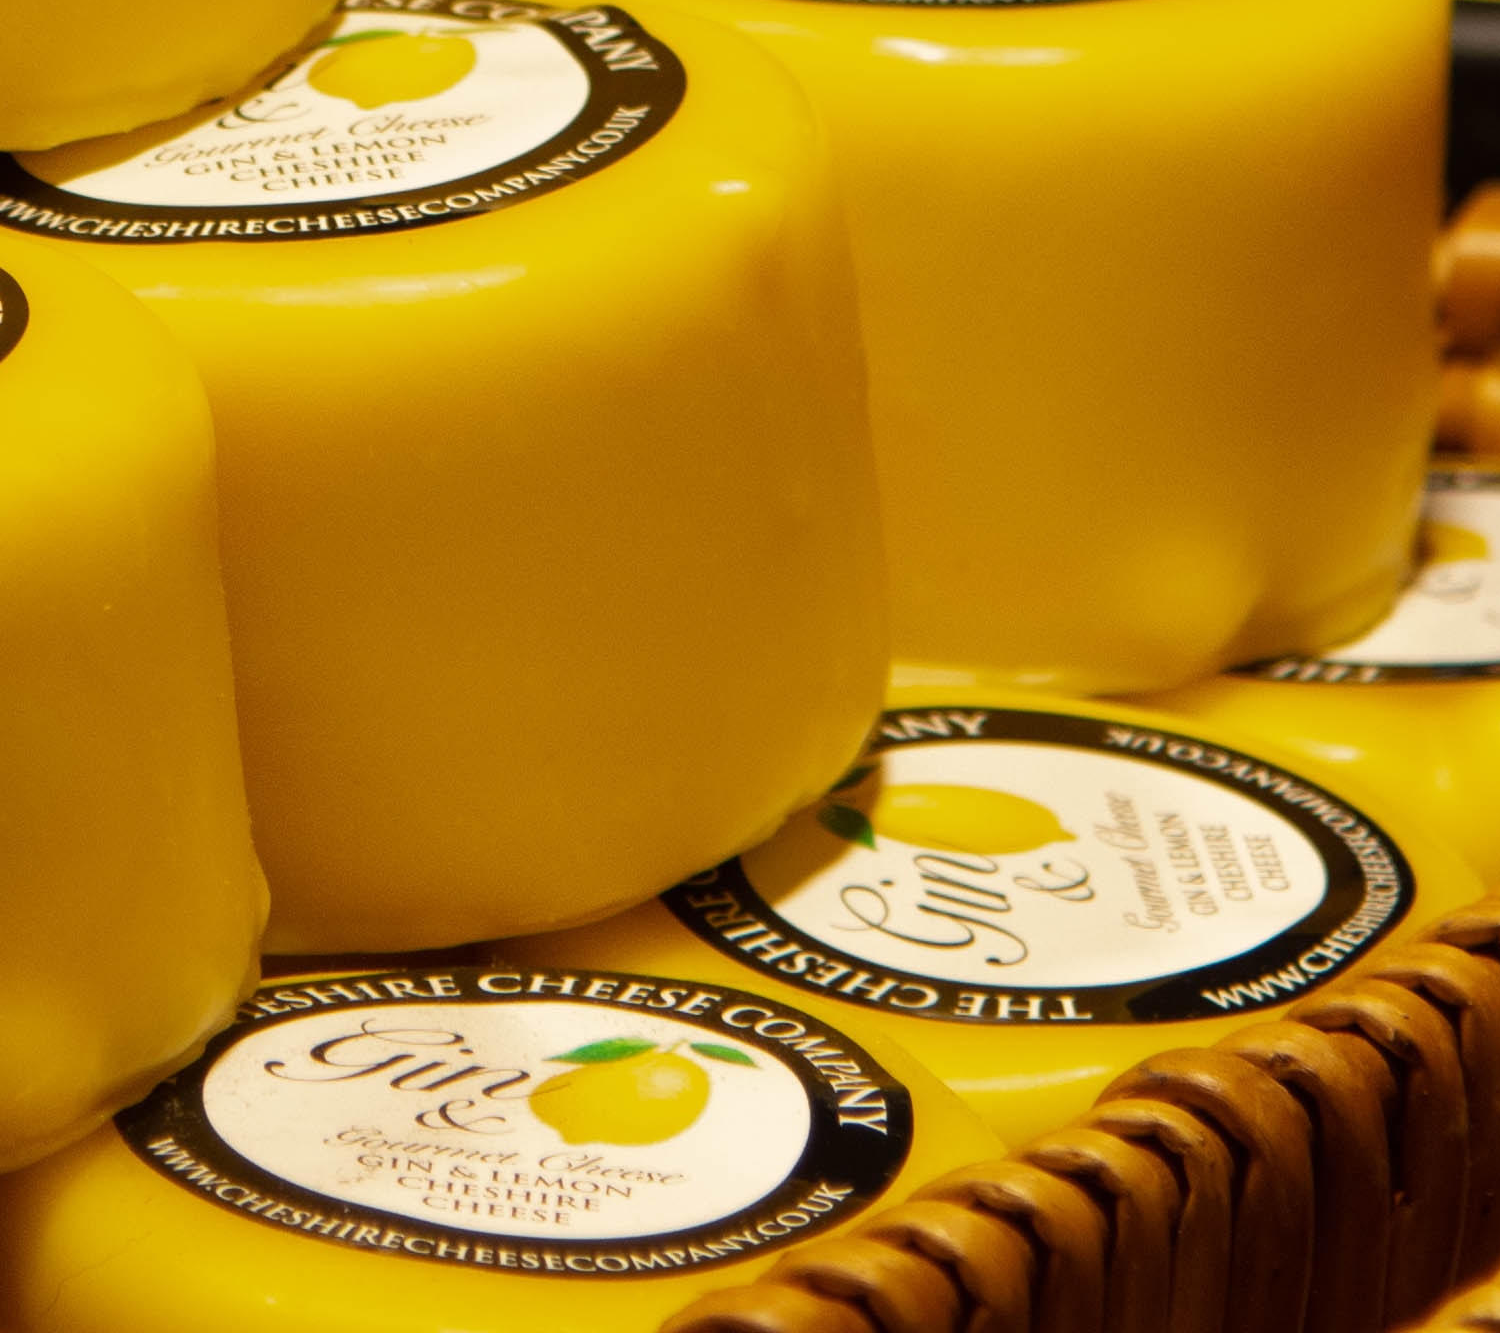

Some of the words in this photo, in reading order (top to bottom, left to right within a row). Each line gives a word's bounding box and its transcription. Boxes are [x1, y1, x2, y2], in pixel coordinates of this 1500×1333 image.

[452, 0, 660, 72] COPANY
[184, 154, 257, 176] GIN
[272, 150, 297, 162] &
[311, 134, 448, 158] LEMON
[230, 150, 427, 182] CHESHIRE
[262, 167, 407, 192] CHEESE
[831, 853, 1028, 966] Gin
[687, 892, 940, 1010] CHESHIRE
[954, 992, 1093, 1021] THE
[238, 975, 462, 1020] ESHIRE
[477, 971, 722, 1017] CHEESE
[720, 1004, 889, 1136] COMPANY
[263, 1018, 550, 1101] Gin
[414, 1099, 508, 1134] &
[323, 1124, 521, 1165] Gourmet
[538, 1151, 686, 1185] Cheese
[356, 1154, 434, 1174] GIN
[449, 1164, 479, 1180] &
[491, 1169, 633, 1200] LEMON
[146, 1136, 854, 1274] WWW.CHESHIRECHEESECOMPANY.CO.UK
[396, 1175, 601, 1213] CHESHIRE
[421, 1194, 572, 1226] CHEESE
